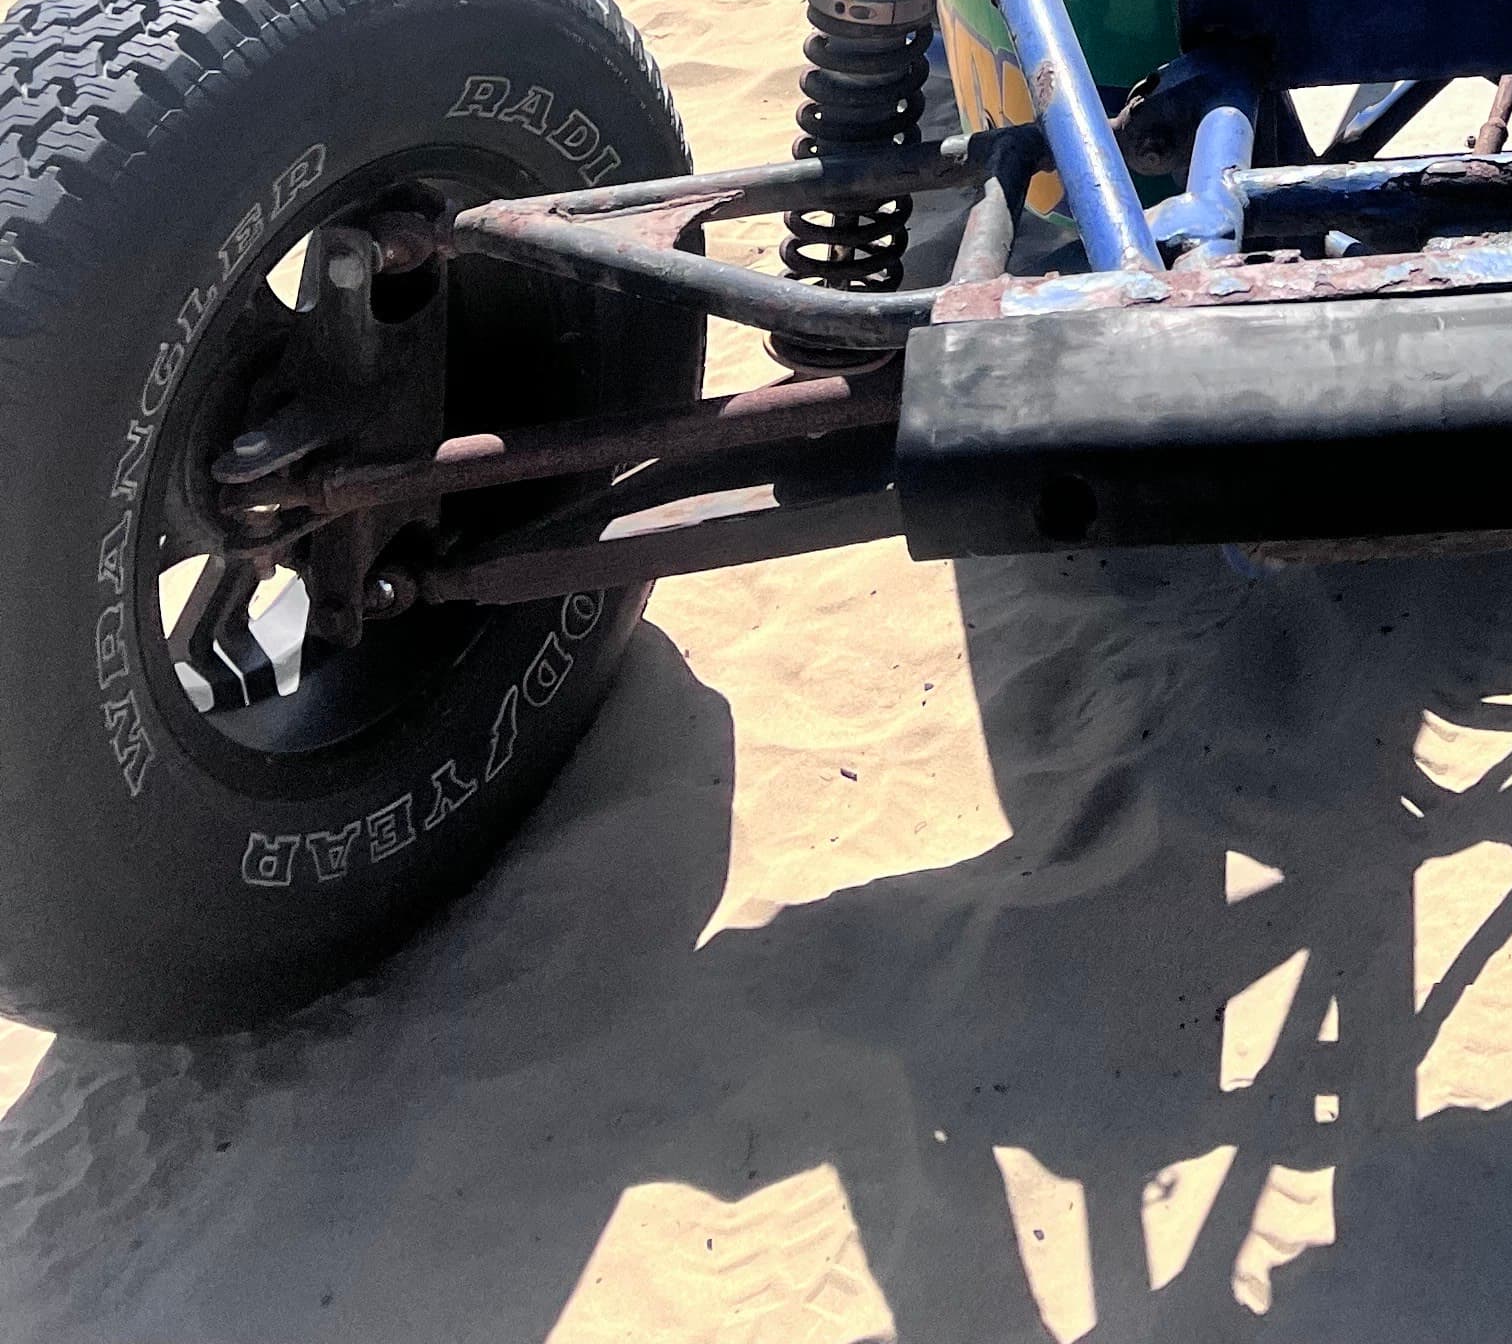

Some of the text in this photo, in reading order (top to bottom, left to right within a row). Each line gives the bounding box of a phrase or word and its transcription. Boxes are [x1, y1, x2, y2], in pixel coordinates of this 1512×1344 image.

[447, 75, 621, 188] RADI
[96, 142, 326, 796] WRANGLER
[242, 591, 605, 887] ODYEAR
